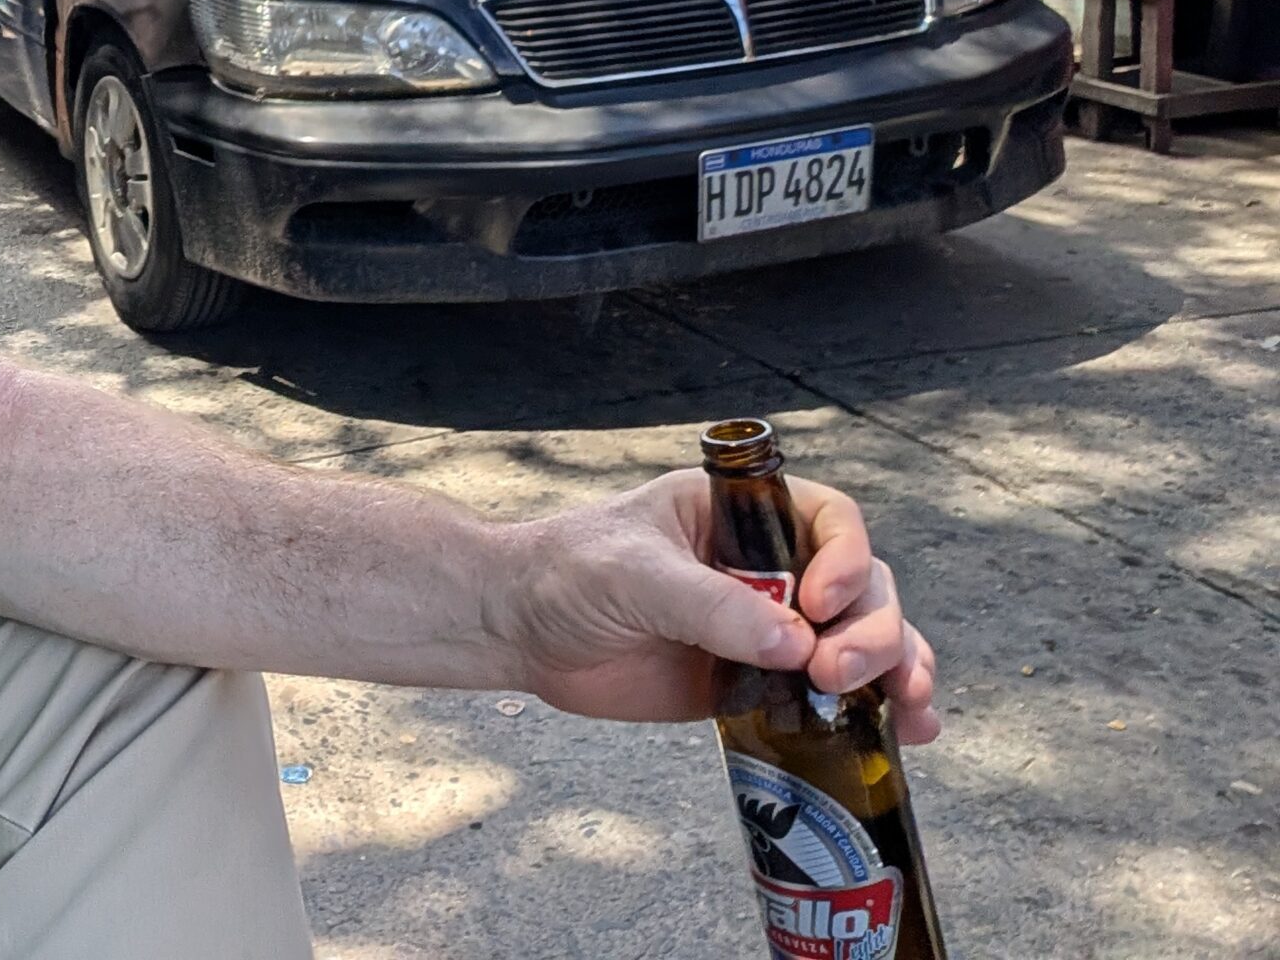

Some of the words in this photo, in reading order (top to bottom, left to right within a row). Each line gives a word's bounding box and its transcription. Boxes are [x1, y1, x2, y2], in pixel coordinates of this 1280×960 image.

[750, 138, 823, 160] HONDURAS
[783, 151, 865, 206] 4824
[805, 805, 836, 833] SABOR
[838, 838, 865, 878] CALIDAD
[766, 894, 869, 939] allo
[771, 930, 829, 954] CERVEZA
